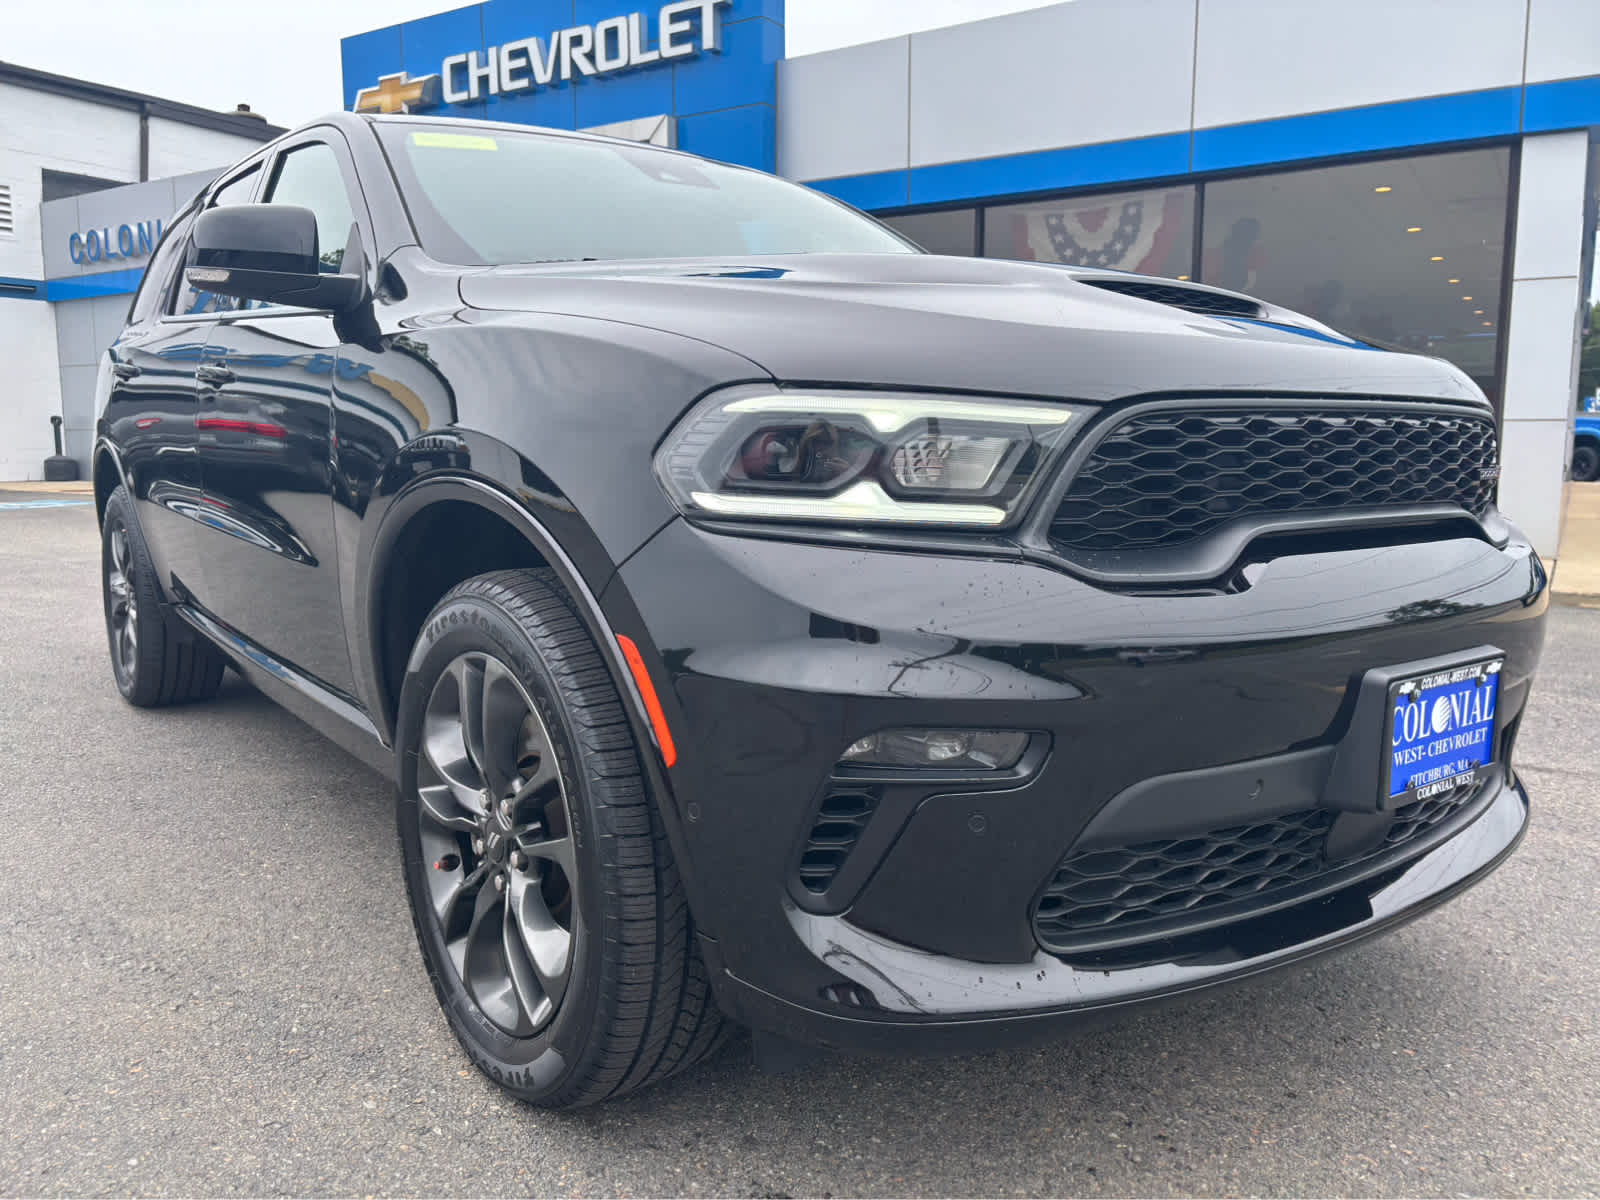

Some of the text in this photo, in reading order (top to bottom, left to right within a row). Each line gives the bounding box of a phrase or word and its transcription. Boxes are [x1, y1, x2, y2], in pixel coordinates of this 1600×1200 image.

[441, 0, 731, 104] CHEVROLET
[1420, 665, 1482, 690] COLONIAL-WEST.COM
[1392, 685, 1495, 746] COLONIAL
[1416, 771, 1475, 800] COLONIAL WEST
